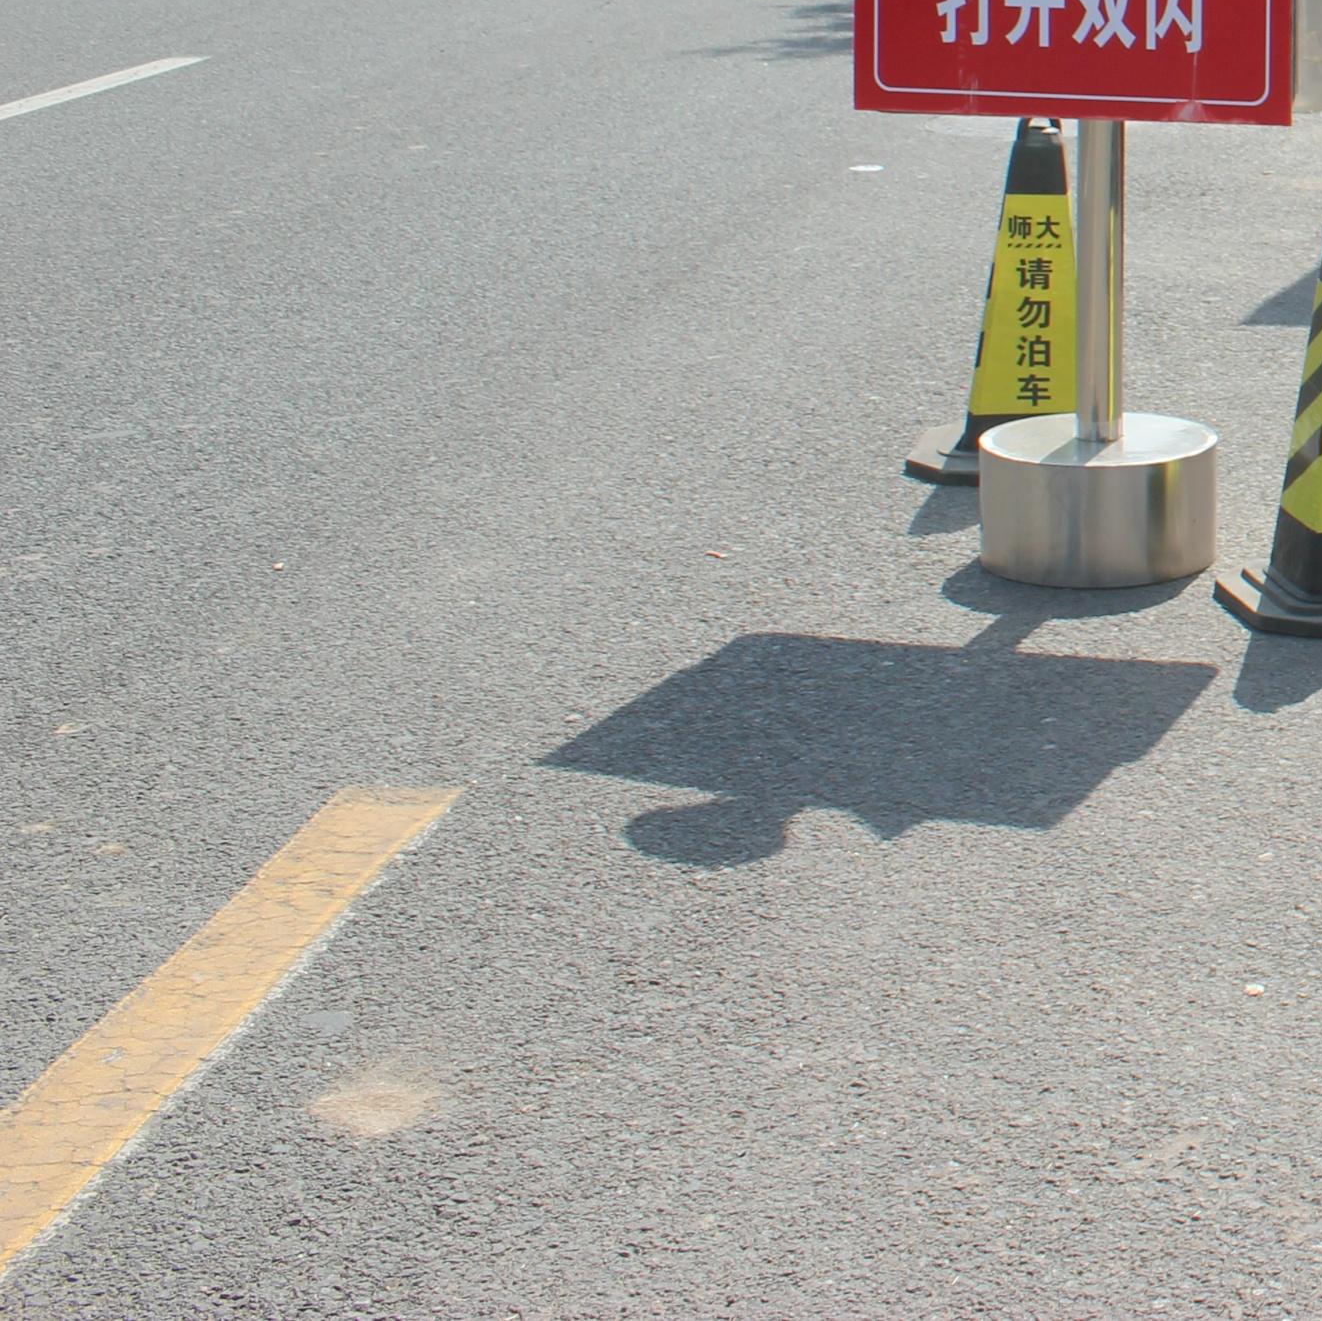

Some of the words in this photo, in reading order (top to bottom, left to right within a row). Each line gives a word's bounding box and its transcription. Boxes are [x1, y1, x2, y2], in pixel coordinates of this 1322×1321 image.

[1006, 215, 1061, 241] 师大
[1015, 257, 1053, 407] 请勿泊车
